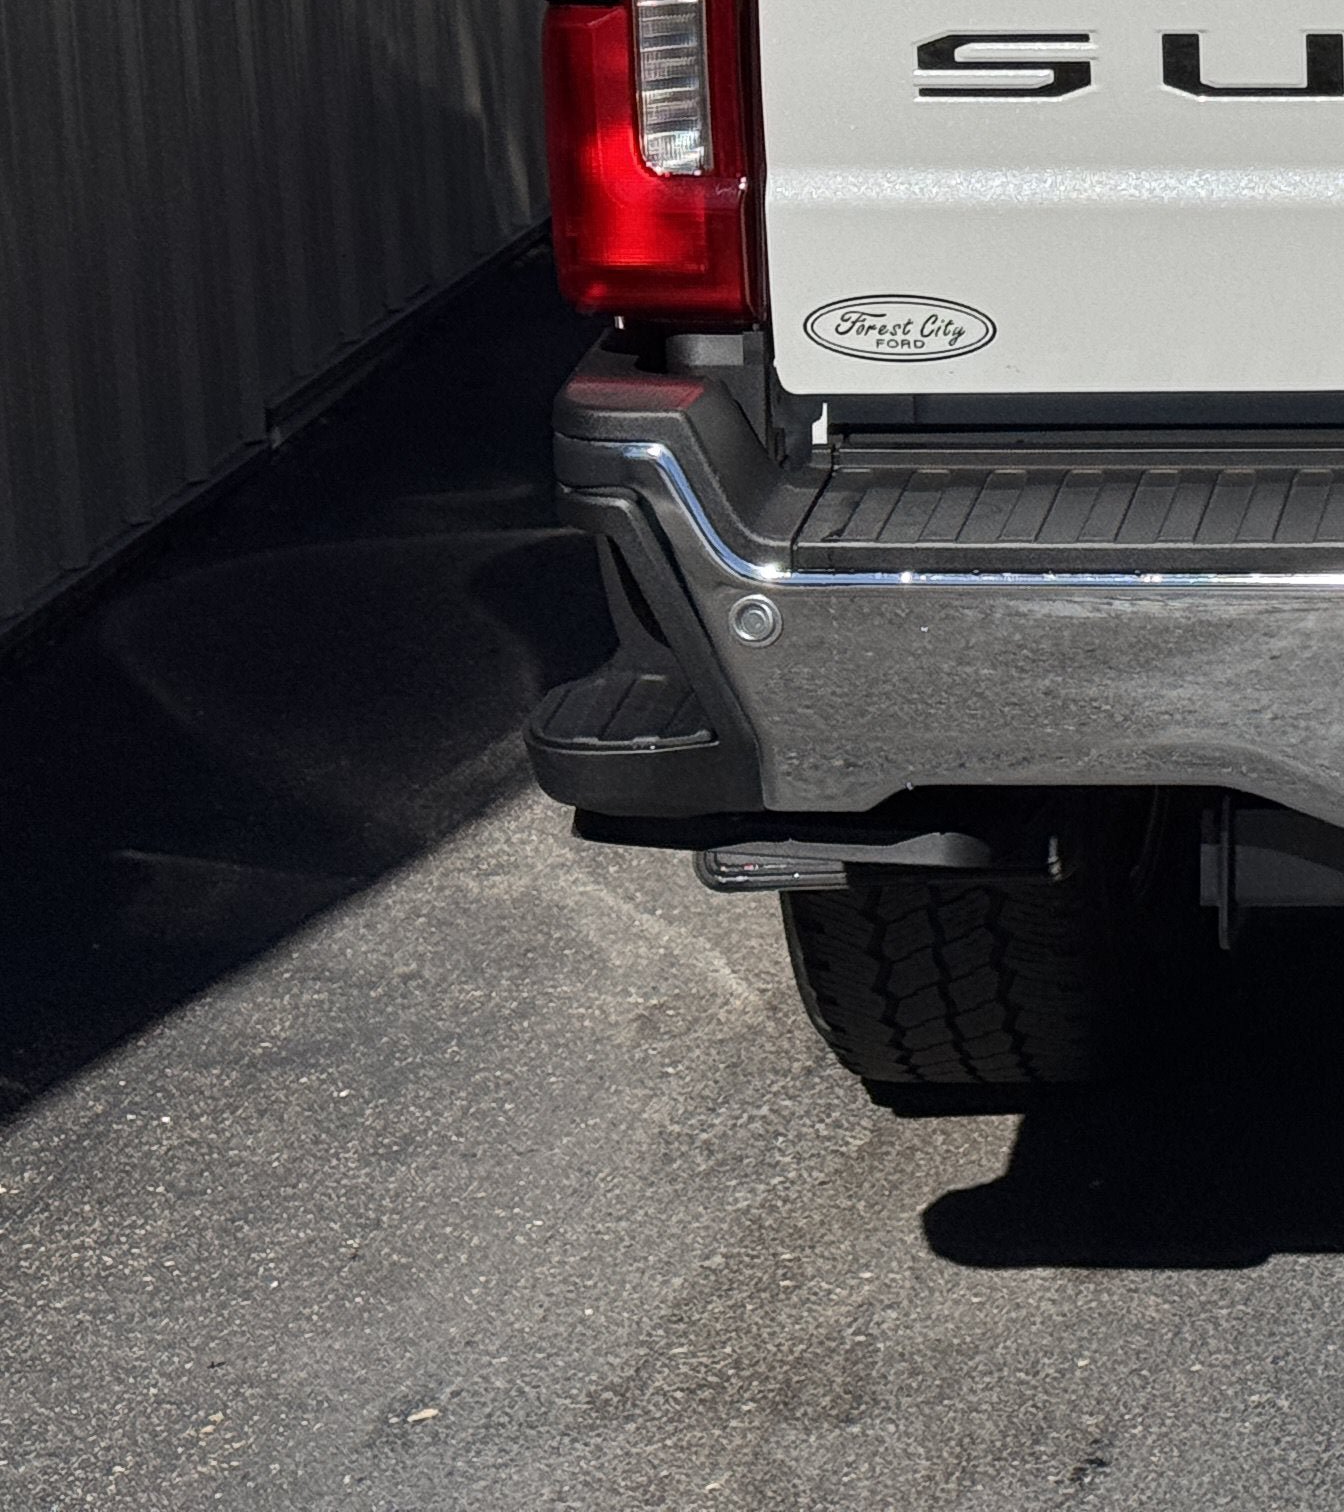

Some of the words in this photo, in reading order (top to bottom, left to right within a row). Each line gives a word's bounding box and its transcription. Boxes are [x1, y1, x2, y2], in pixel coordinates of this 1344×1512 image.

[834, 310, 914, 336] Forest
[919, 313, 966, 347] City
[875, 338, 926, 350] FORD
